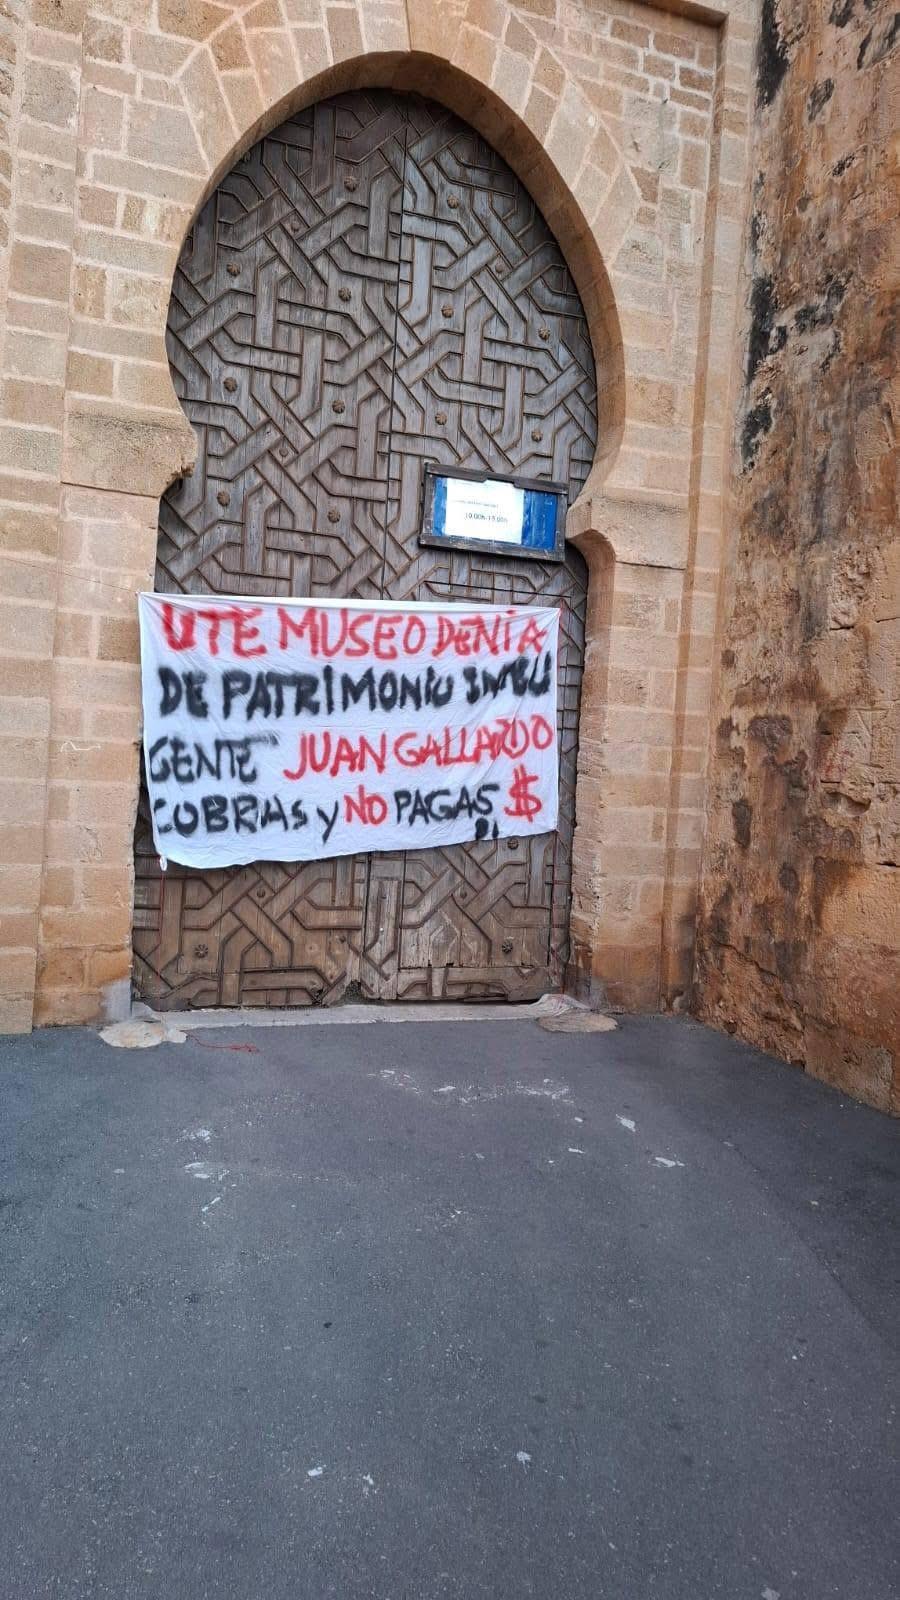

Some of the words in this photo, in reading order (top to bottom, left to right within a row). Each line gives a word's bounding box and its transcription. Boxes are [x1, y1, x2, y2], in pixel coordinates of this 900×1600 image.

[162, 602, 267, 657] UTE
[277, 606, 427, 660] MUSEO
[158, 665, 209, 718] DE
[283, 731, 386, 780] JUAN
[393, 714, 554, 767] GALLARDO
[152, 794, 307, 837] COBRAS
[344, 784, 388, 826] NO
